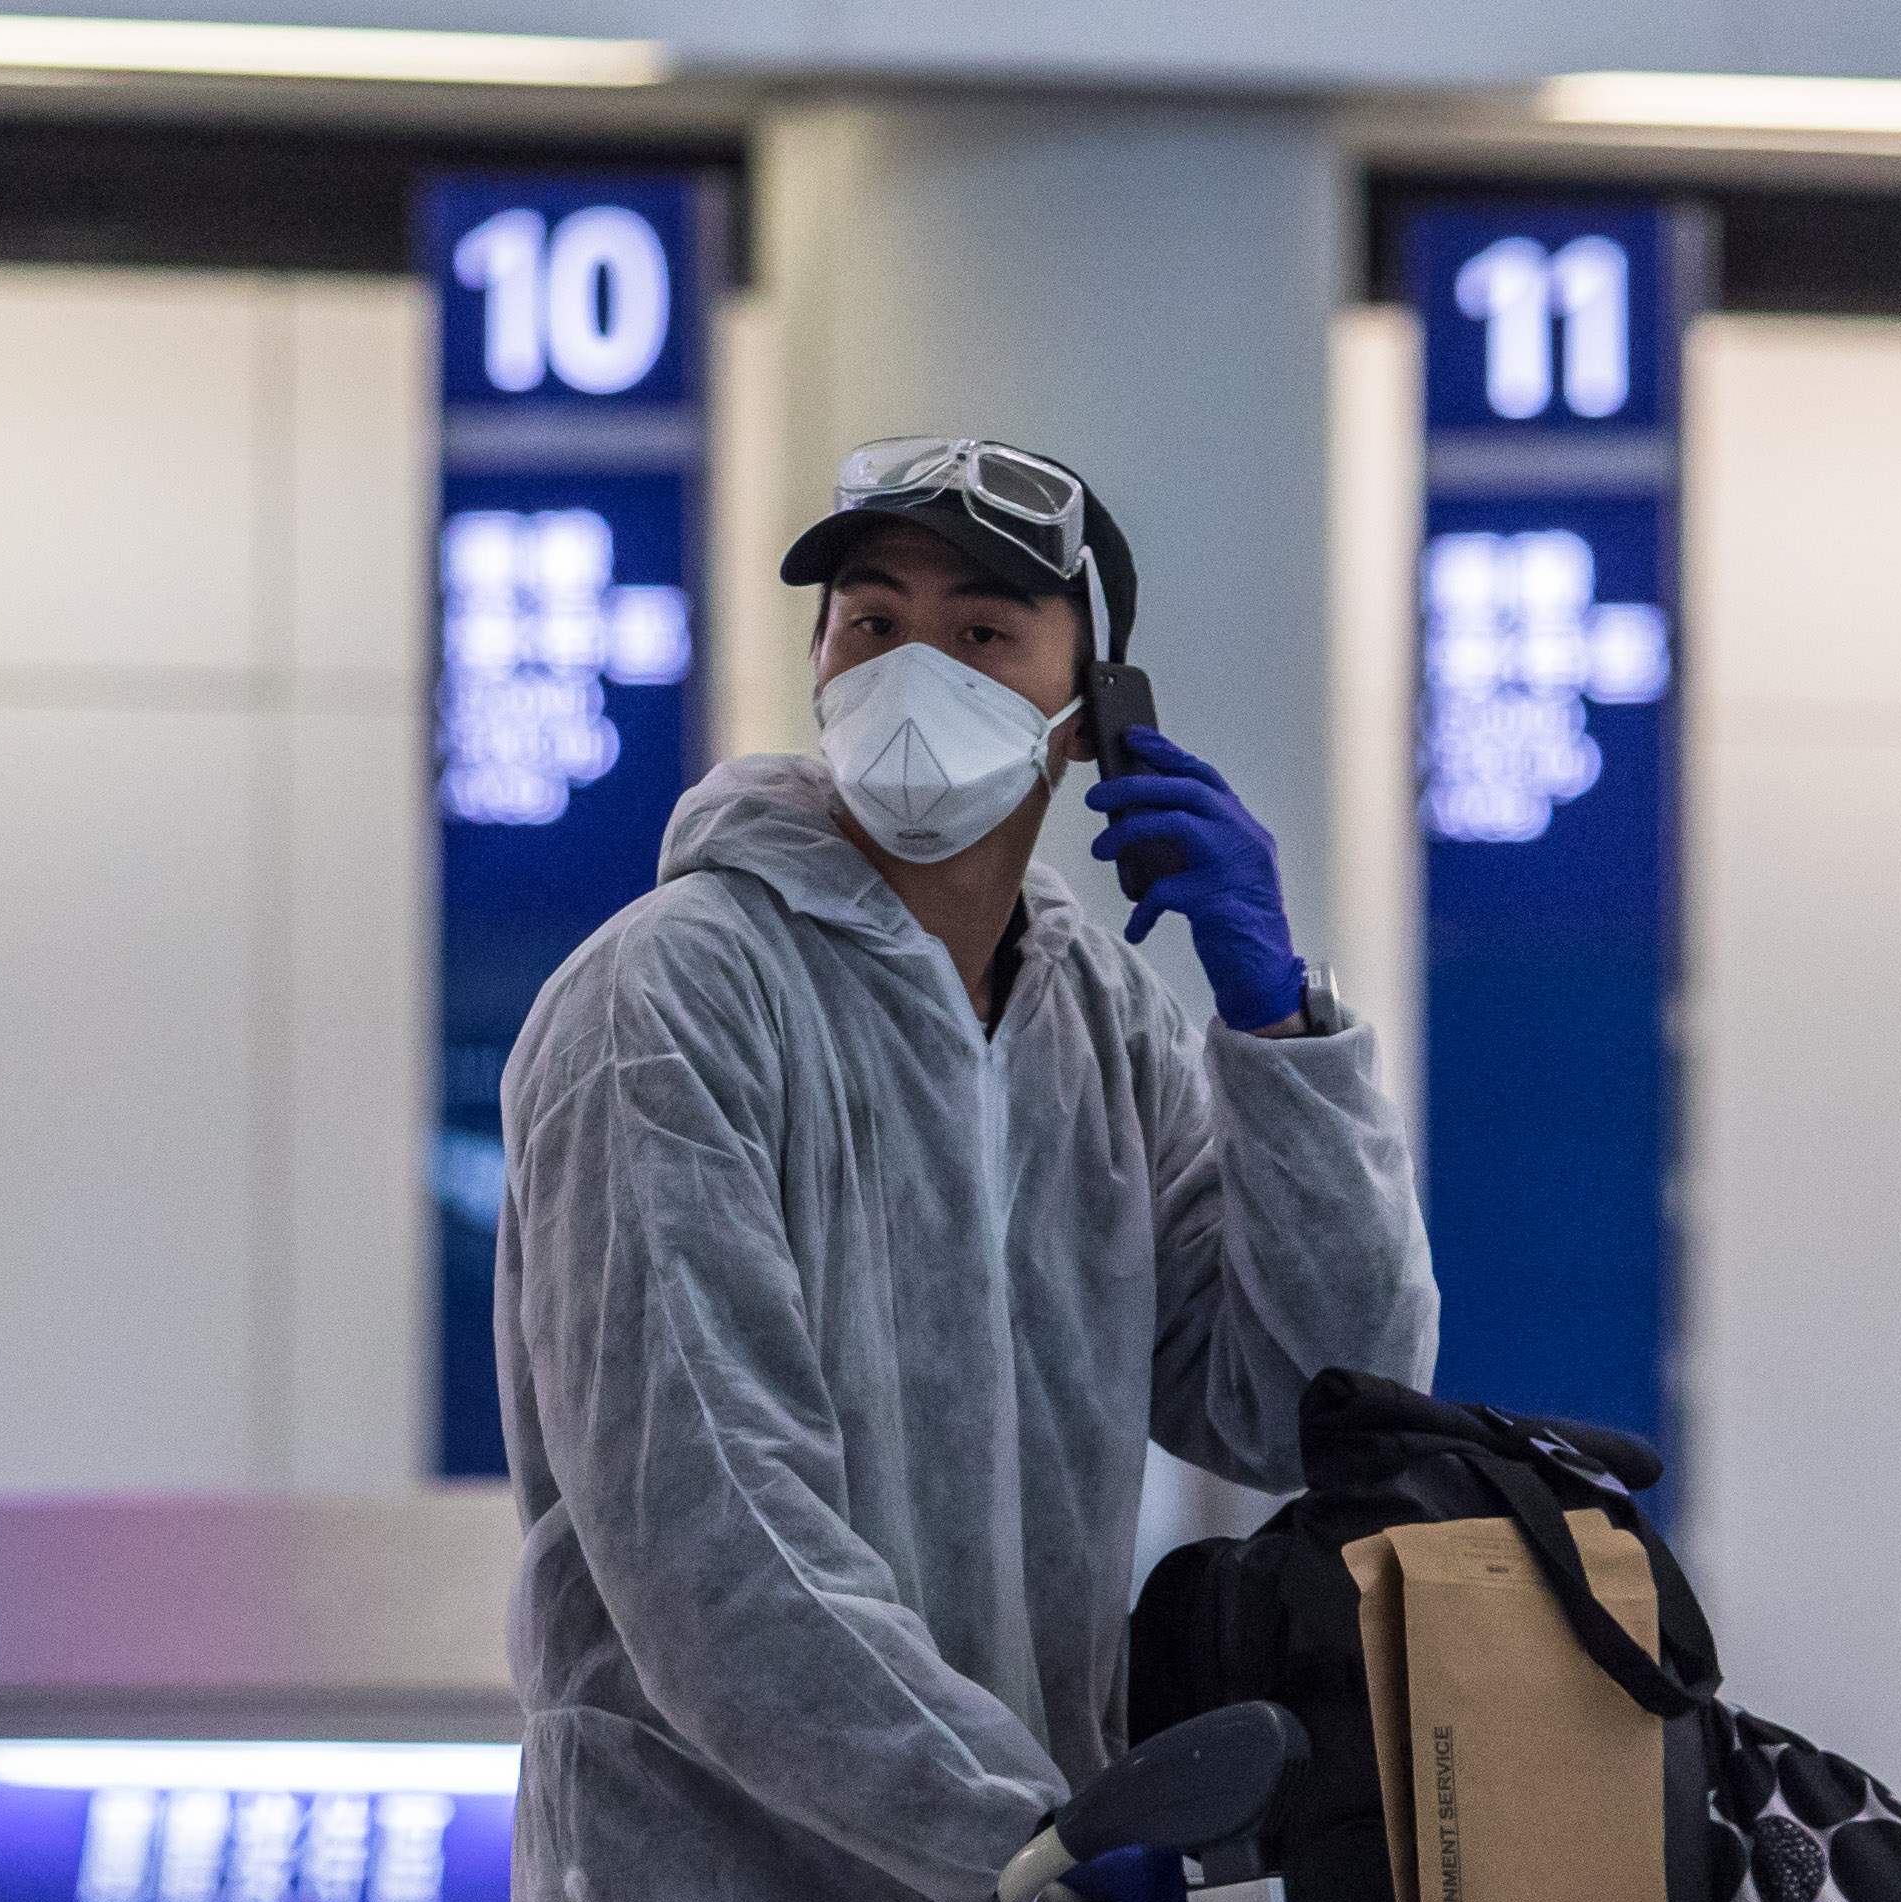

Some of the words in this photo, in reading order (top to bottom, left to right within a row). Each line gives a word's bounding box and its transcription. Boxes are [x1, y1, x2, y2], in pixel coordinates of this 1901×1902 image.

[453, 204, 671, 395] 10
[1454, 234, 1630, 420] 11
[1434, 1726, 1456, 1821] SERVICE
